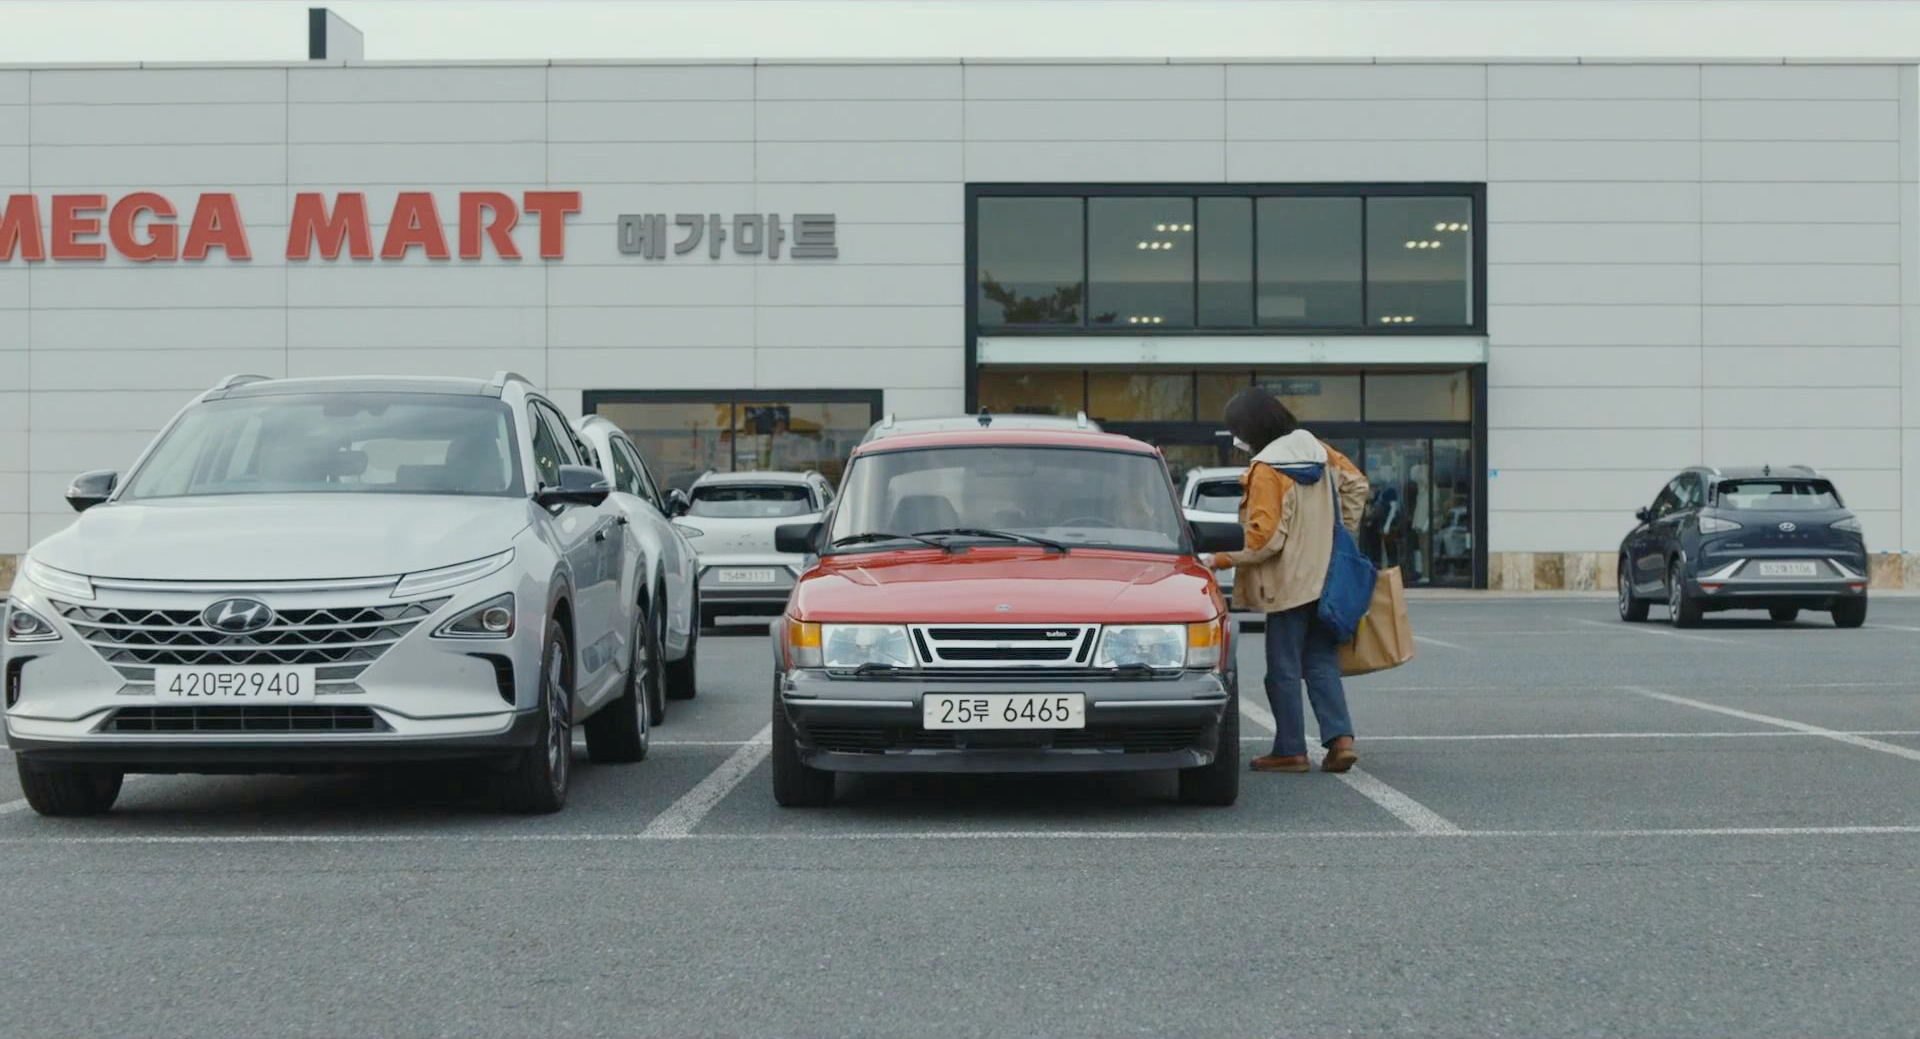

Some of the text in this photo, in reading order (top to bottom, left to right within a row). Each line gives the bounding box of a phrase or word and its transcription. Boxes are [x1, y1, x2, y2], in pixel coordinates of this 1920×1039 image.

[286, 191, 582, 260] MART
[617, 213, 839, 260] 메가마트
[169, 672, 300, 697] 420무2940
[940, 697, 1070, 723] 25루 6465
